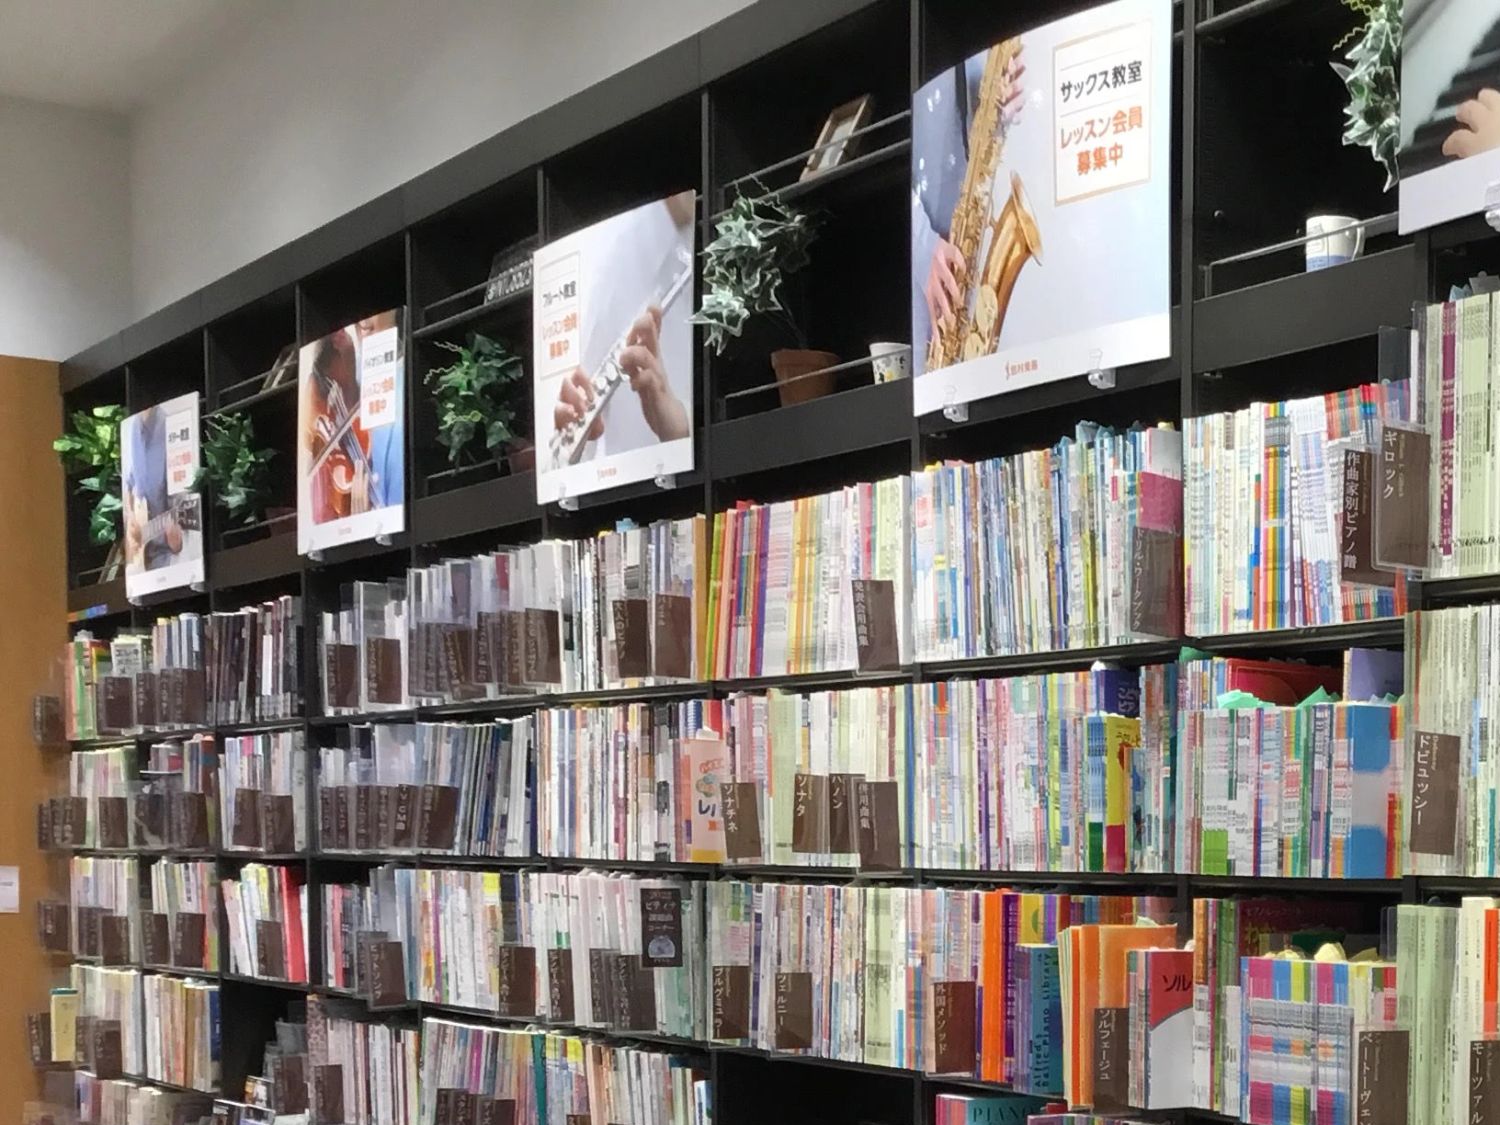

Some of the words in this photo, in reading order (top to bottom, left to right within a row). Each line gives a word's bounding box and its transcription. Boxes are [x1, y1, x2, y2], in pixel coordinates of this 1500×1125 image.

[1061, 60, 1143, 103] サックス教室
[1060, 105, 1143, 149] レッスン会員
[1077, 142, 1124, 175] 募集中
[1383, 430, 1398, 500] ギロック
[1416, 735, 1430, 825] ドビュッシー
